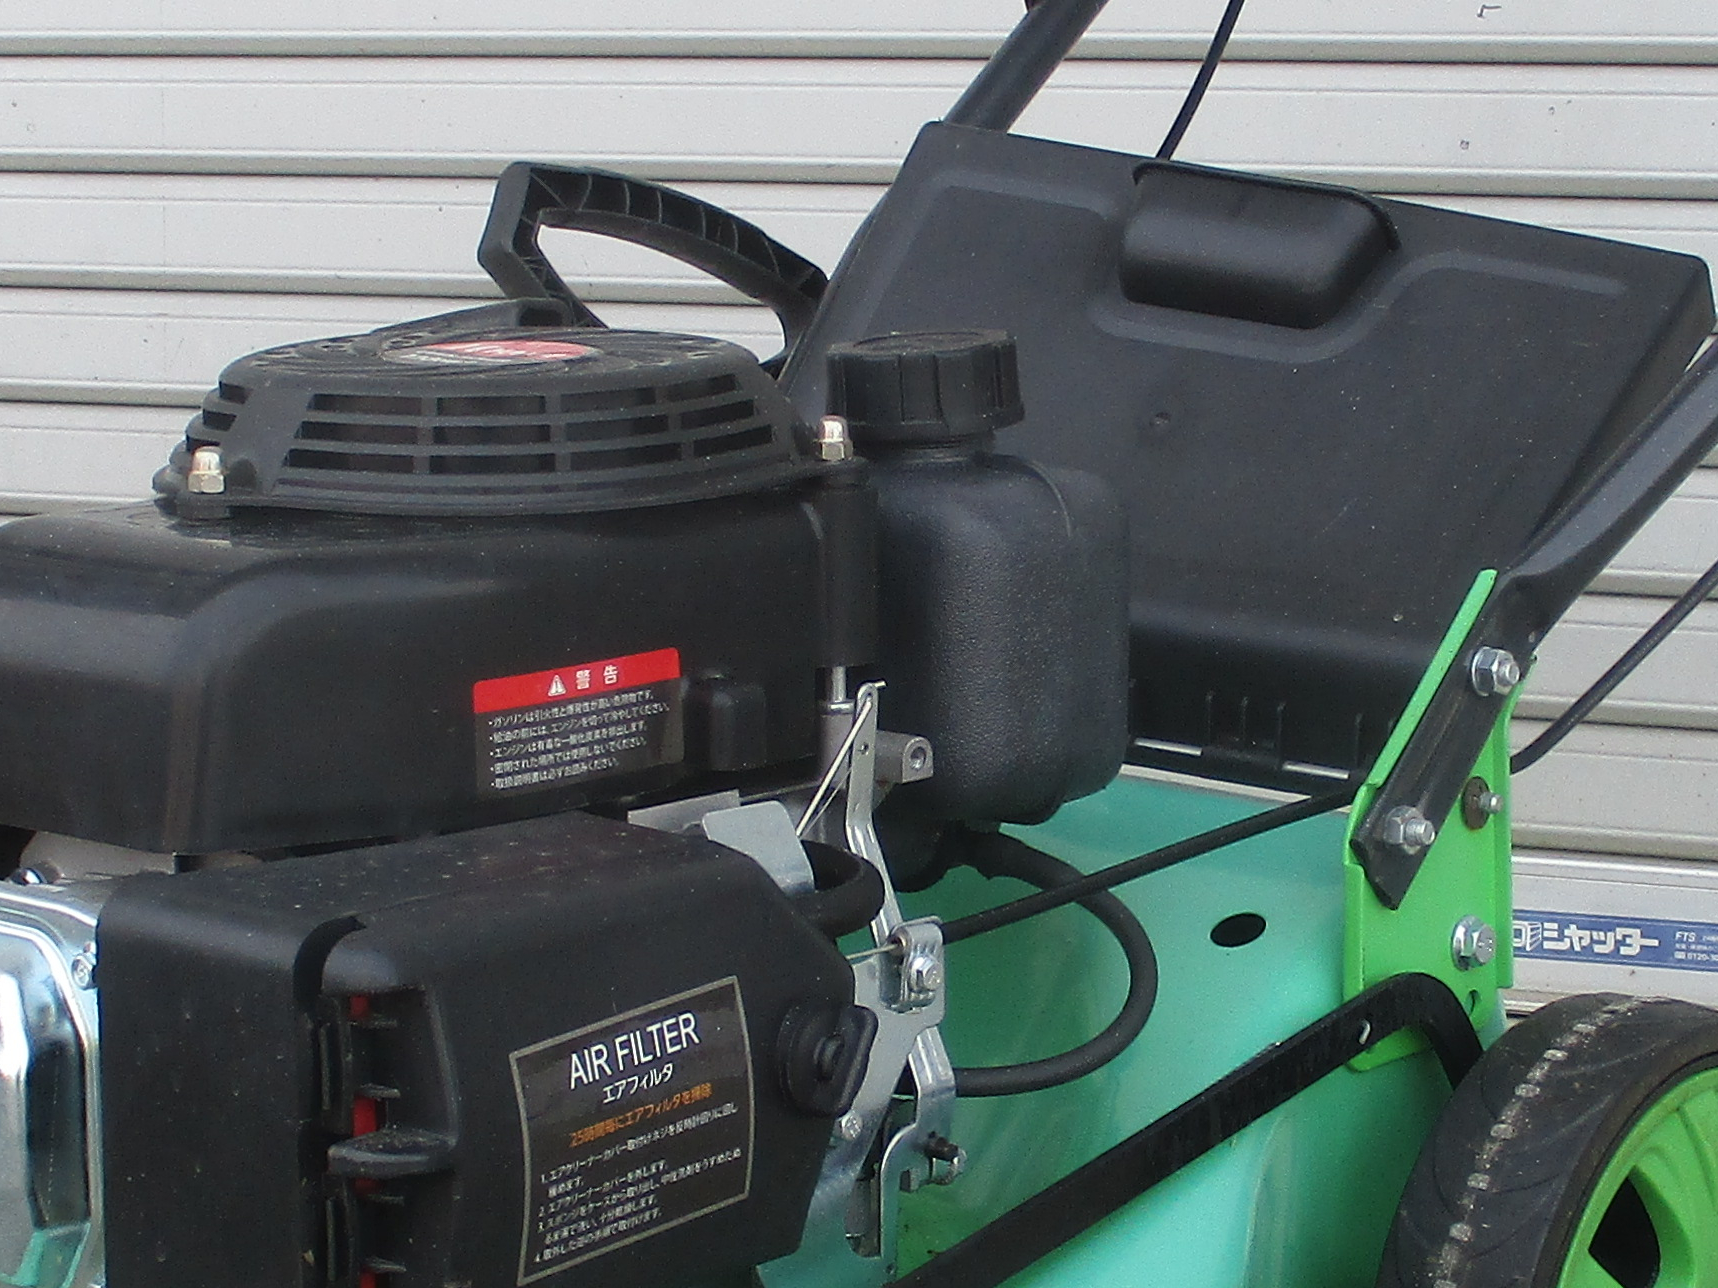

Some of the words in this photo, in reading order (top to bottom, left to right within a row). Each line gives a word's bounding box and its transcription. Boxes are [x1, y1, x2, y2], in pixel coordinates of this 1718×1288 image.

[1675, 931, 1697, 943] FTS
[570, 1043, 613, 1090] AIR
[614, 1012, 701, 1072] FILTER
[602, 1063, 674, 1105] エアフィルタ
